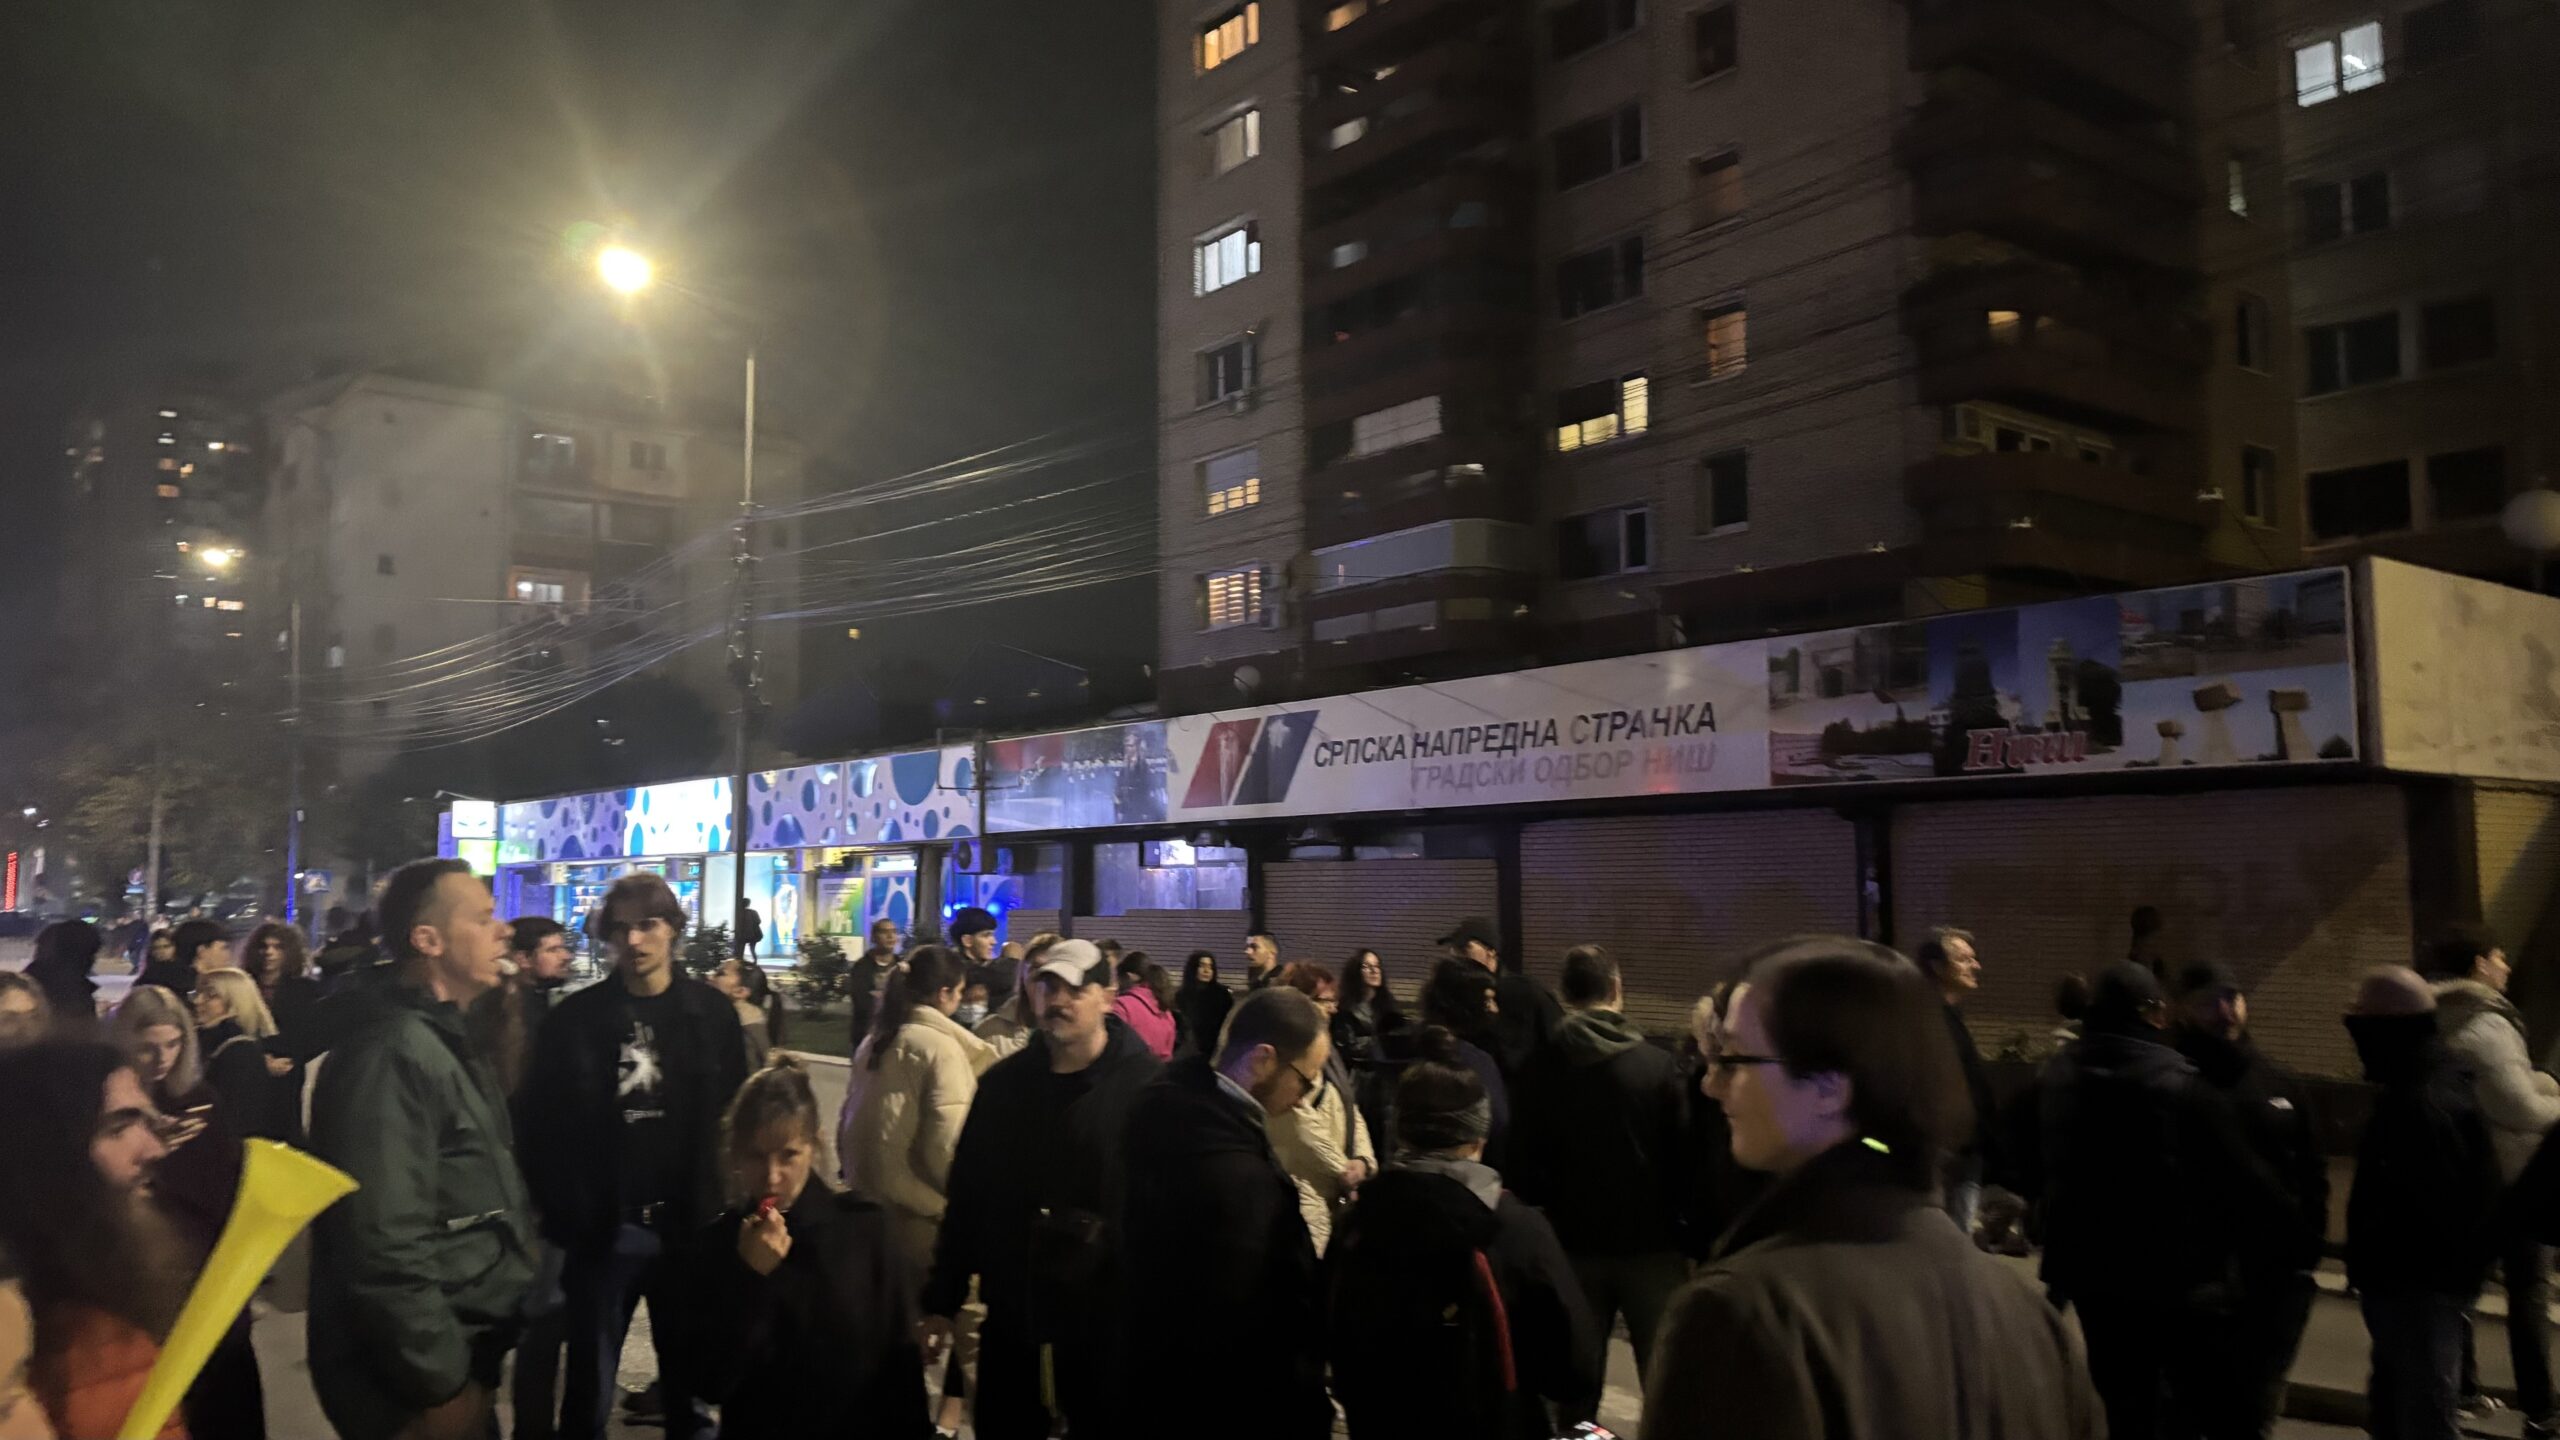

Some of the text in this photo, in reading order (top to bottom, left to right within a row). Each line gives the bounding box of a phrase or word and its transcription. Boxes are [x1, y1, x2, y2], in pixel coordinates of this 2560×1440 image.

[1315, 702, 1716, 767] СРПСКА НАПРЕДНА СТРАНКА
[1412, 758, 1525, 792] ГРАДСКИ
[1534, 750, 1633, 787] ОДБОР
